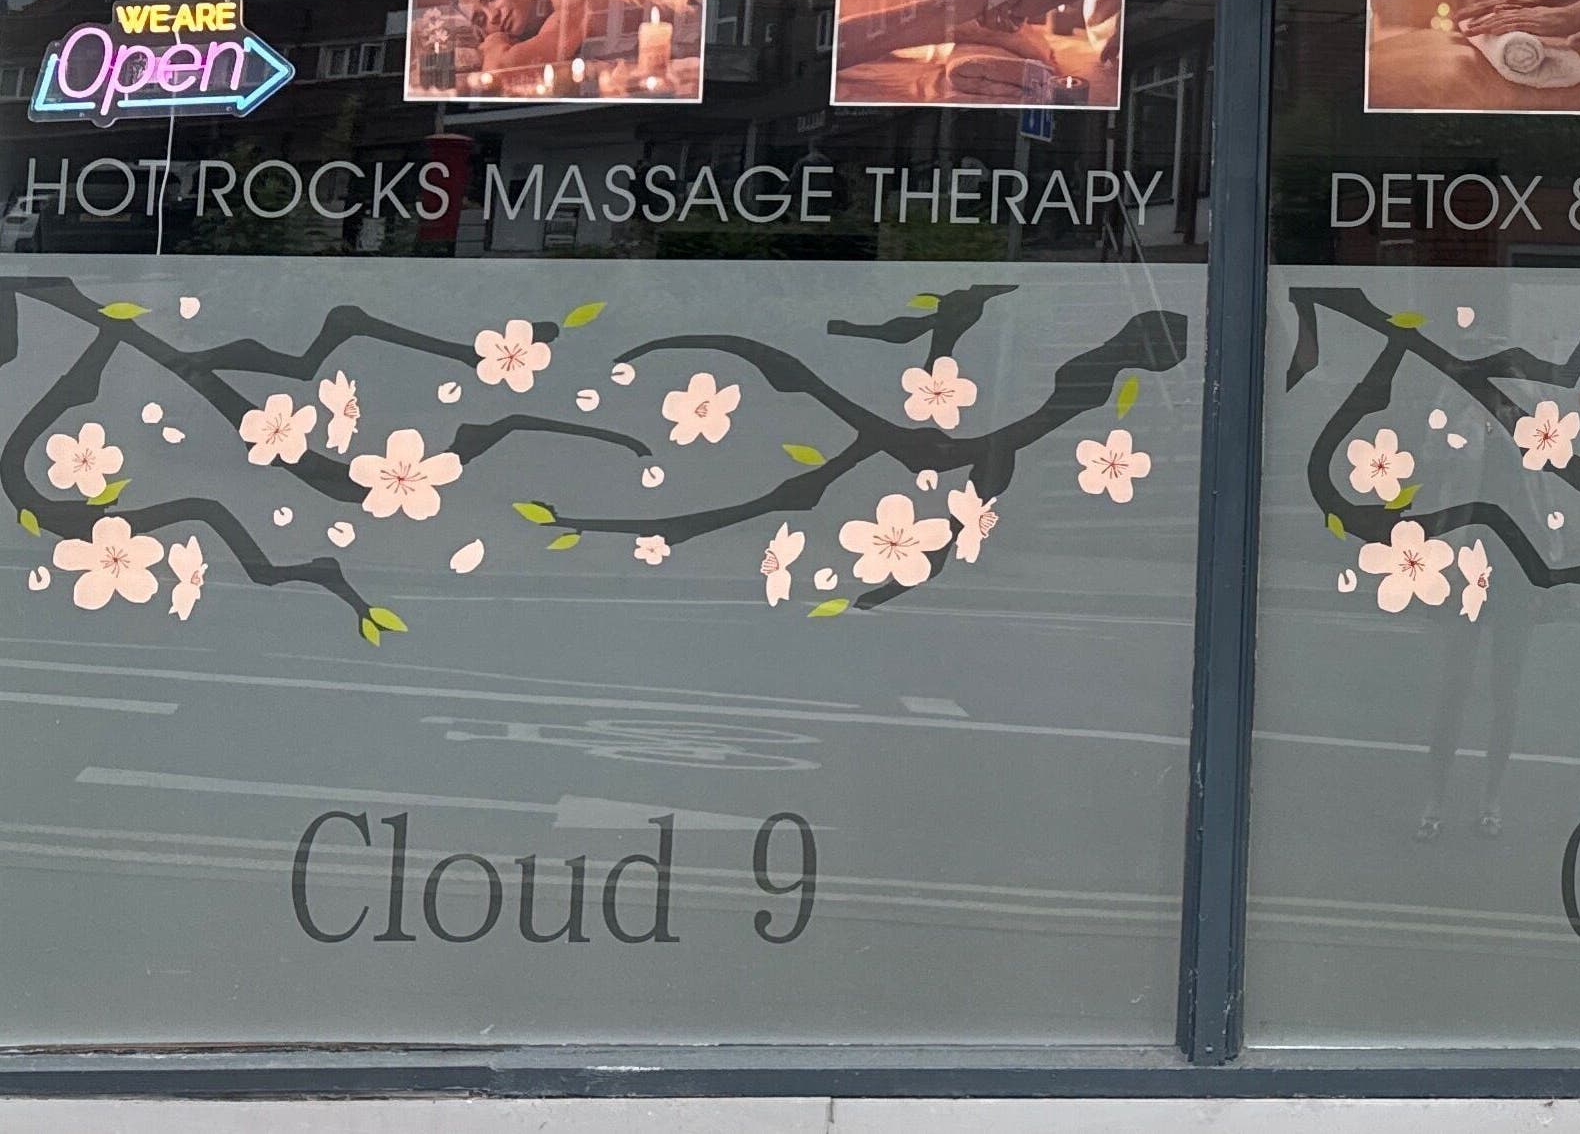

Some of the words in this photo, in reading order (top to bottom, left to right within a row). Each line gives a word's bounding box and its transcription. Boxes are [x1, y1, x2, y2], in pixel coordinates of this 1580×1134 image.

[116, 5, 170, 34] WE
[171, 2, 237, 32] ARE
[57, 26, 246, 115] Open
[25, 157, 170, 216] HOT
[196, 160, 450, 219] ROCKS
[484, 163, 834, 223] MASSAGE
[865, 165, 1164, 226] THERAPY
[1330, 172, 1542, 231] DETOX
[290, 811, 681, 944] Cloud
[752, 812, 818, 944] 9
